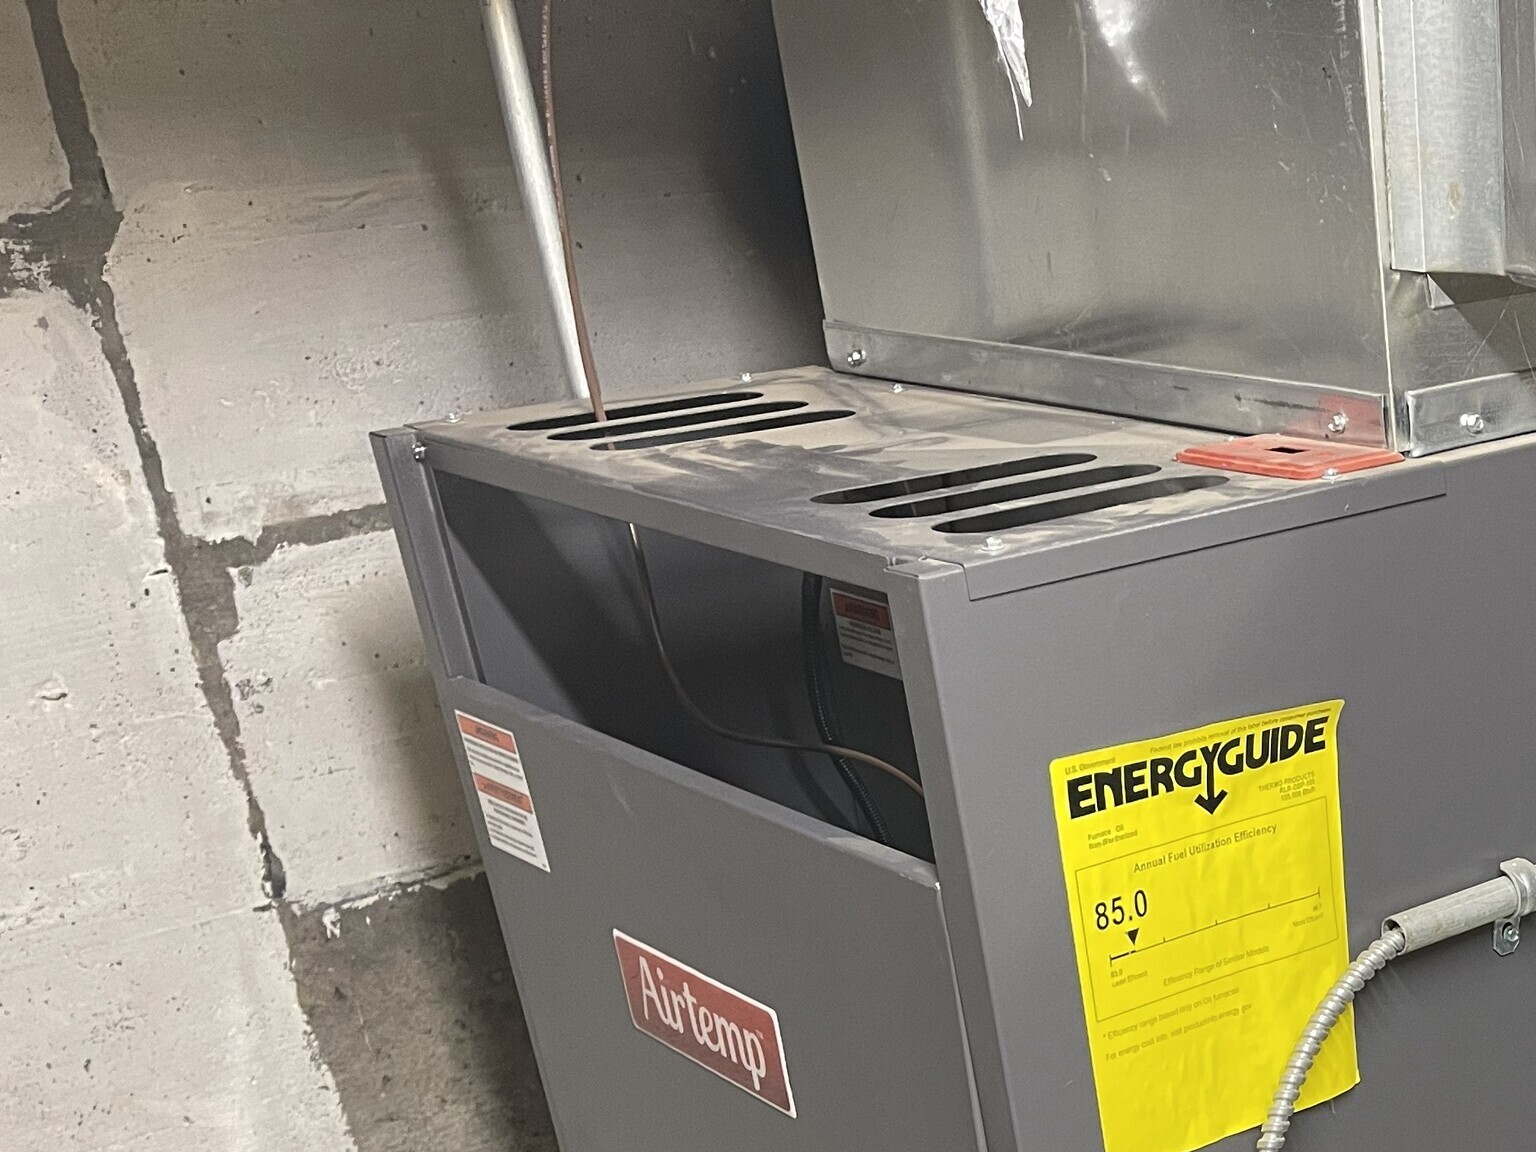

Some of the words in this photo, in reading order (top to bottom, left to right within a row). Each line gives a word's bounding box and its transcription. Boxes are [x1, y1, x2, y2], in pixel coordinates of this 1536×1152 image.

[1066, 715, 1330, 820] ENERGYGUIDE
[1133, 854, 1167, 873] Annual
[1167, 847, 1188, 864] Fuel
[1188, 833, 1233, 857] Utilization
[1234, 822, 1278, 844] Efficiency
[1095, 888, 1149, 931] 85.0
[639, 954, 767, 1092] Airtemp
